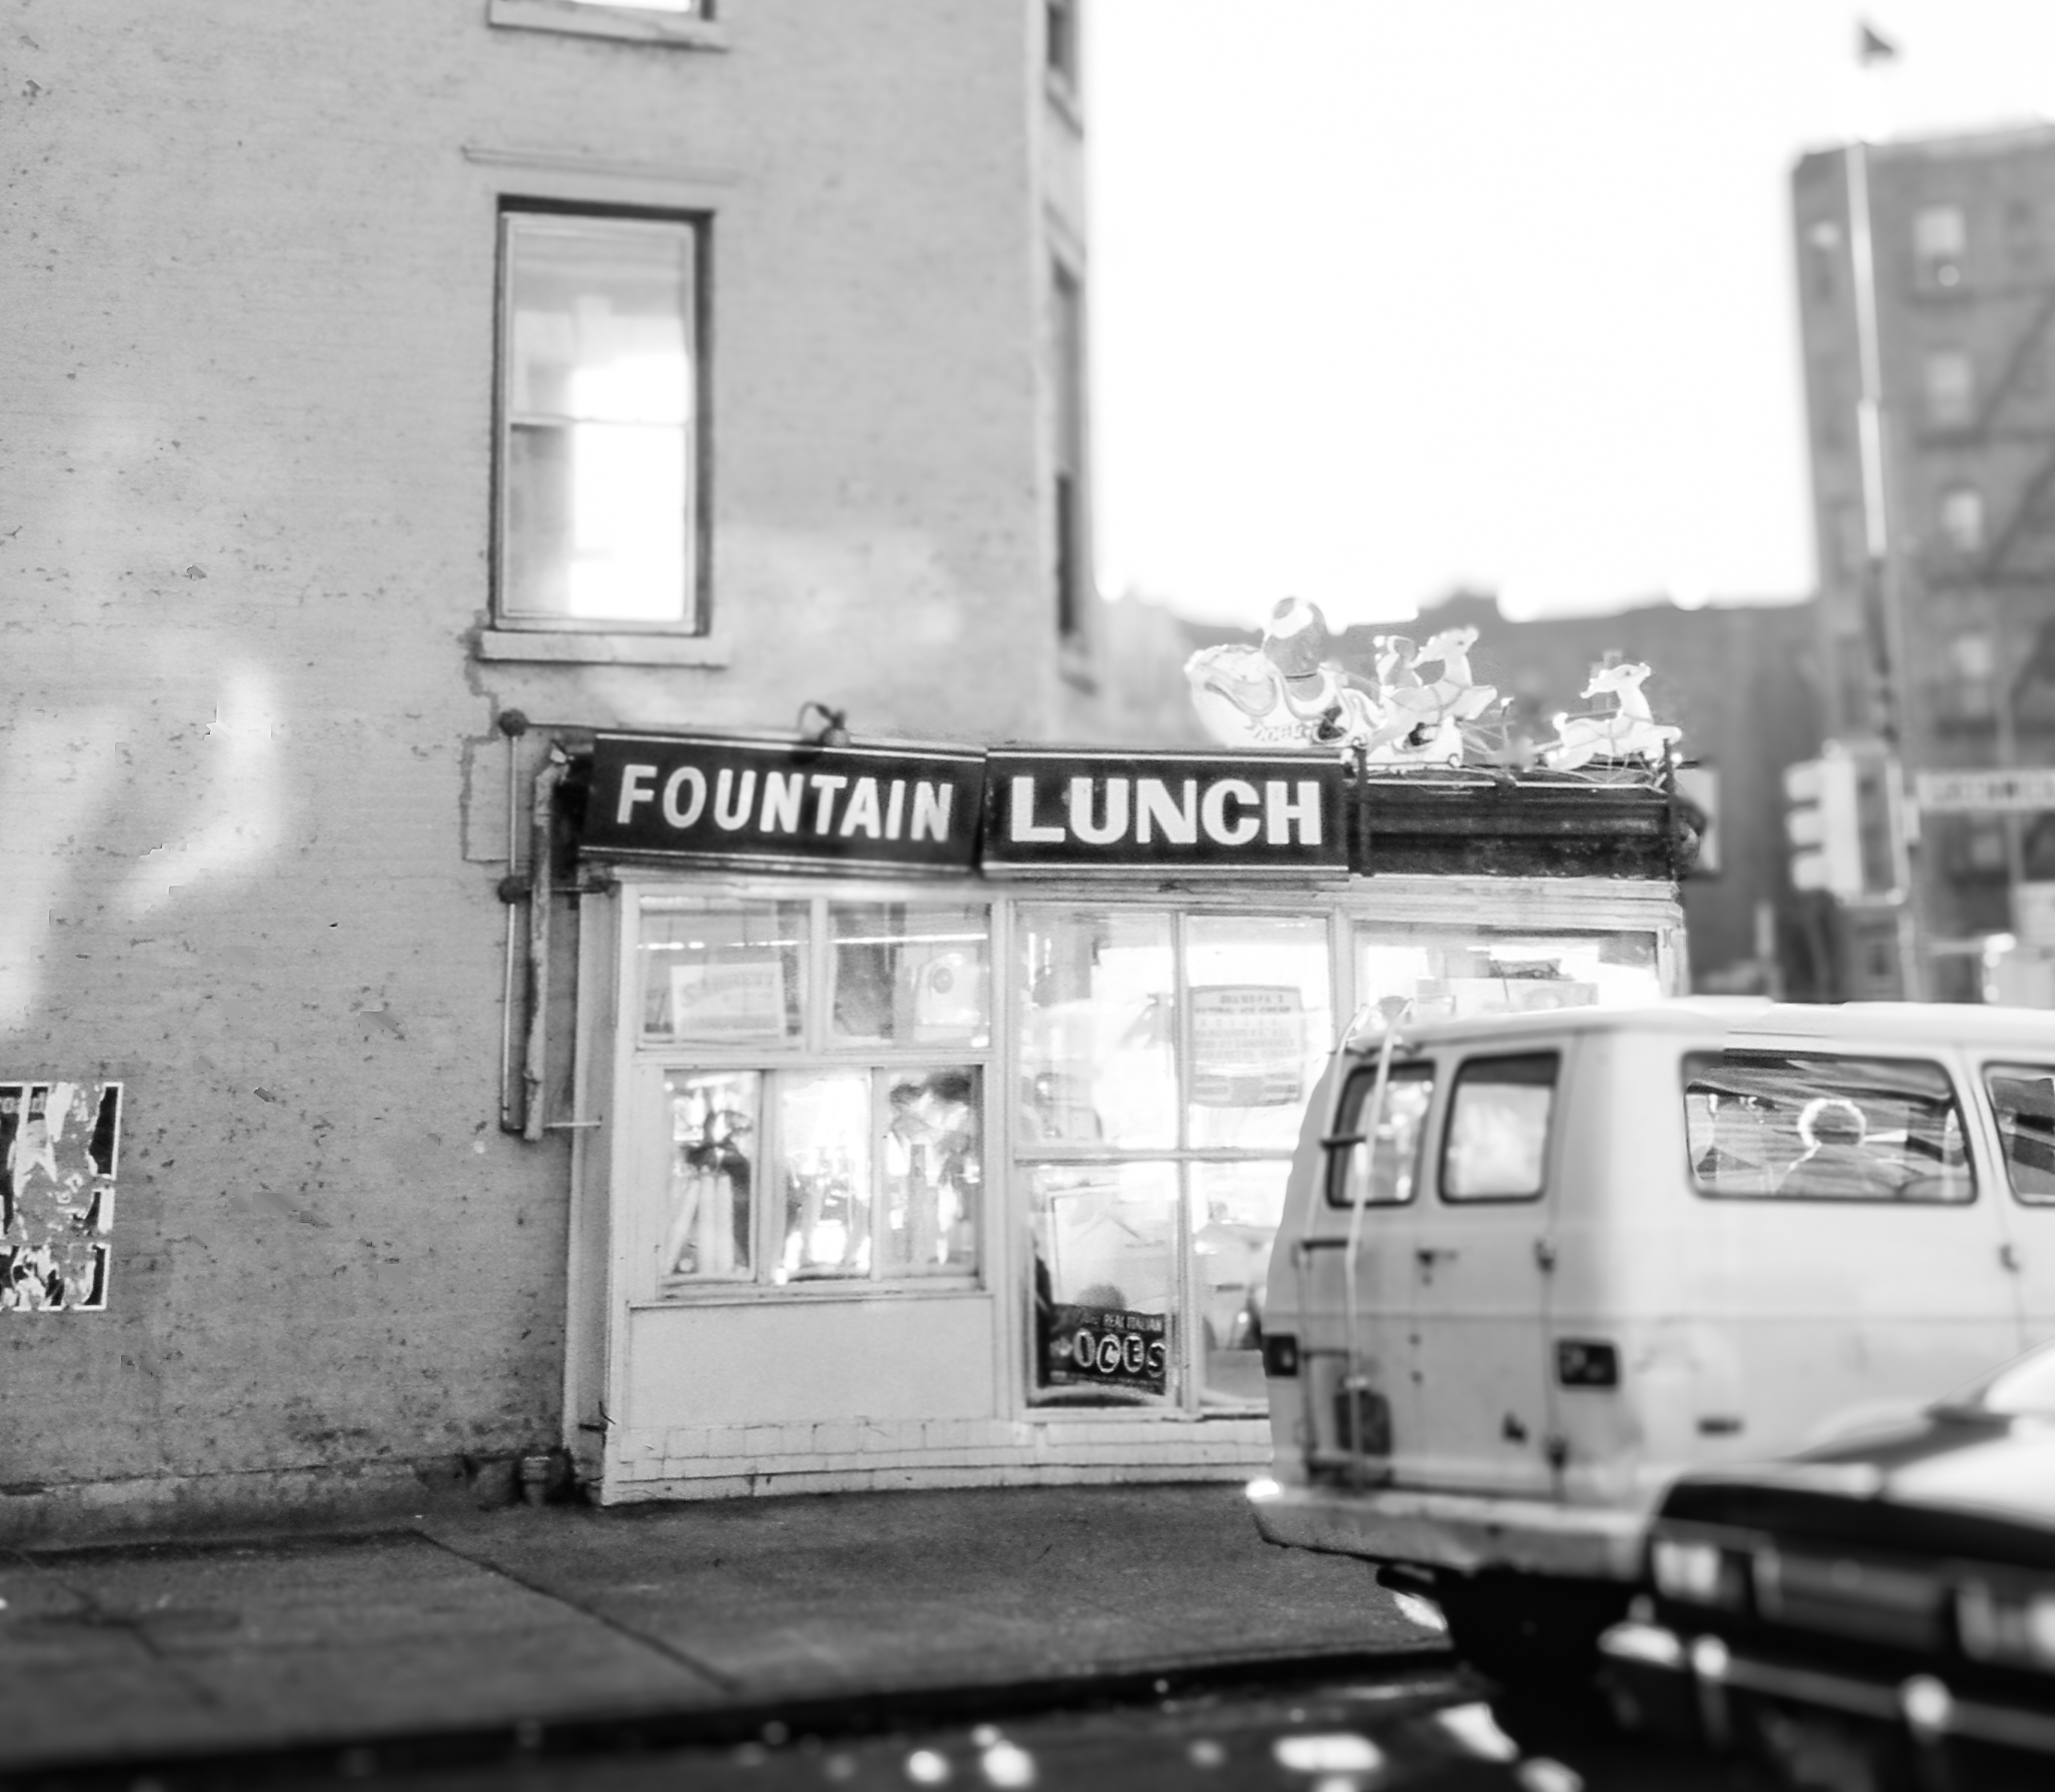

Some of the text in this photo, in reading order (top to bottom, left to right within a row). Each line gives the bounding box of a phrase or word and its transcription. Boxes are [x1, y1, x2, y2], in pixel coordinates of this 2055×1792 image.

[617, 764, 954, 843] FOUNTAIN
[1011, 776, 1322, 846] LUNCH
[1072, 1327, 1166, 1378] ICES
